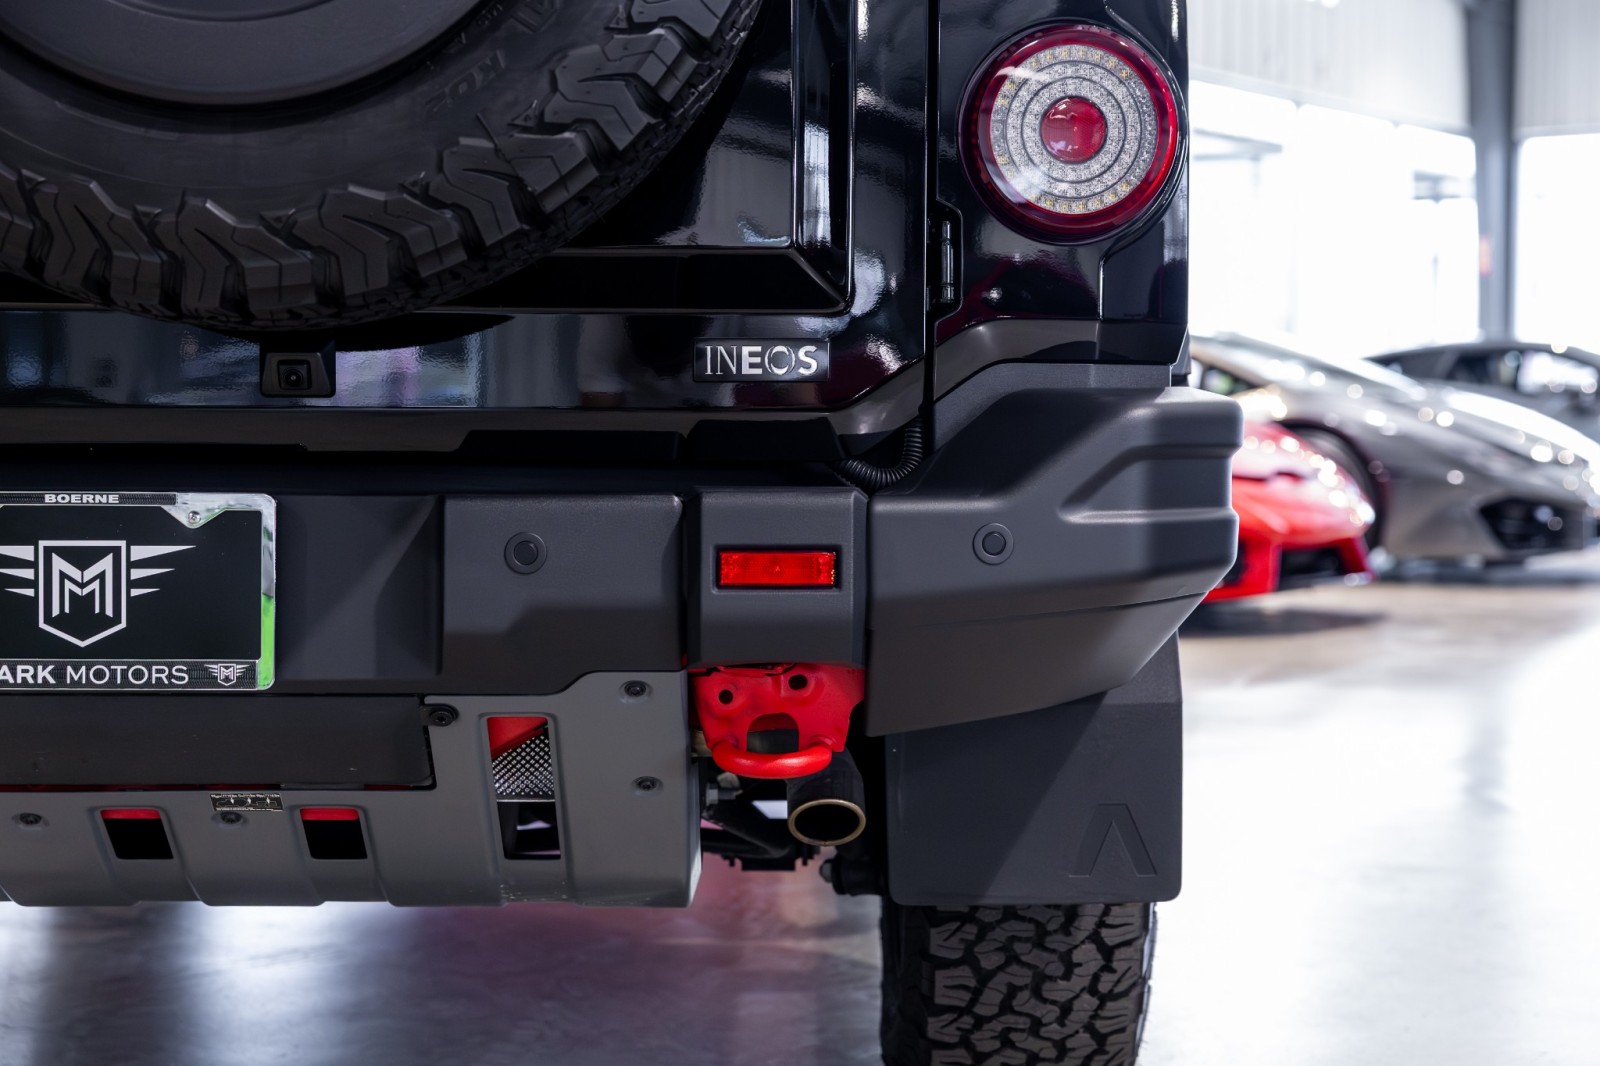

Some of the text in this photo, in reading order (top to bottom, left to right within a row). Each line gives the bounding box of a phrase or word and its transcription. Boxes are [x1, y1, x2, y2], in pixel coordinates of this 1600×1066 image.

[705, 345, 818, 375] INEOS
[44, 494, 119, 503] BOERNE
[0, 665, 189, 684] ARK MOTORS
